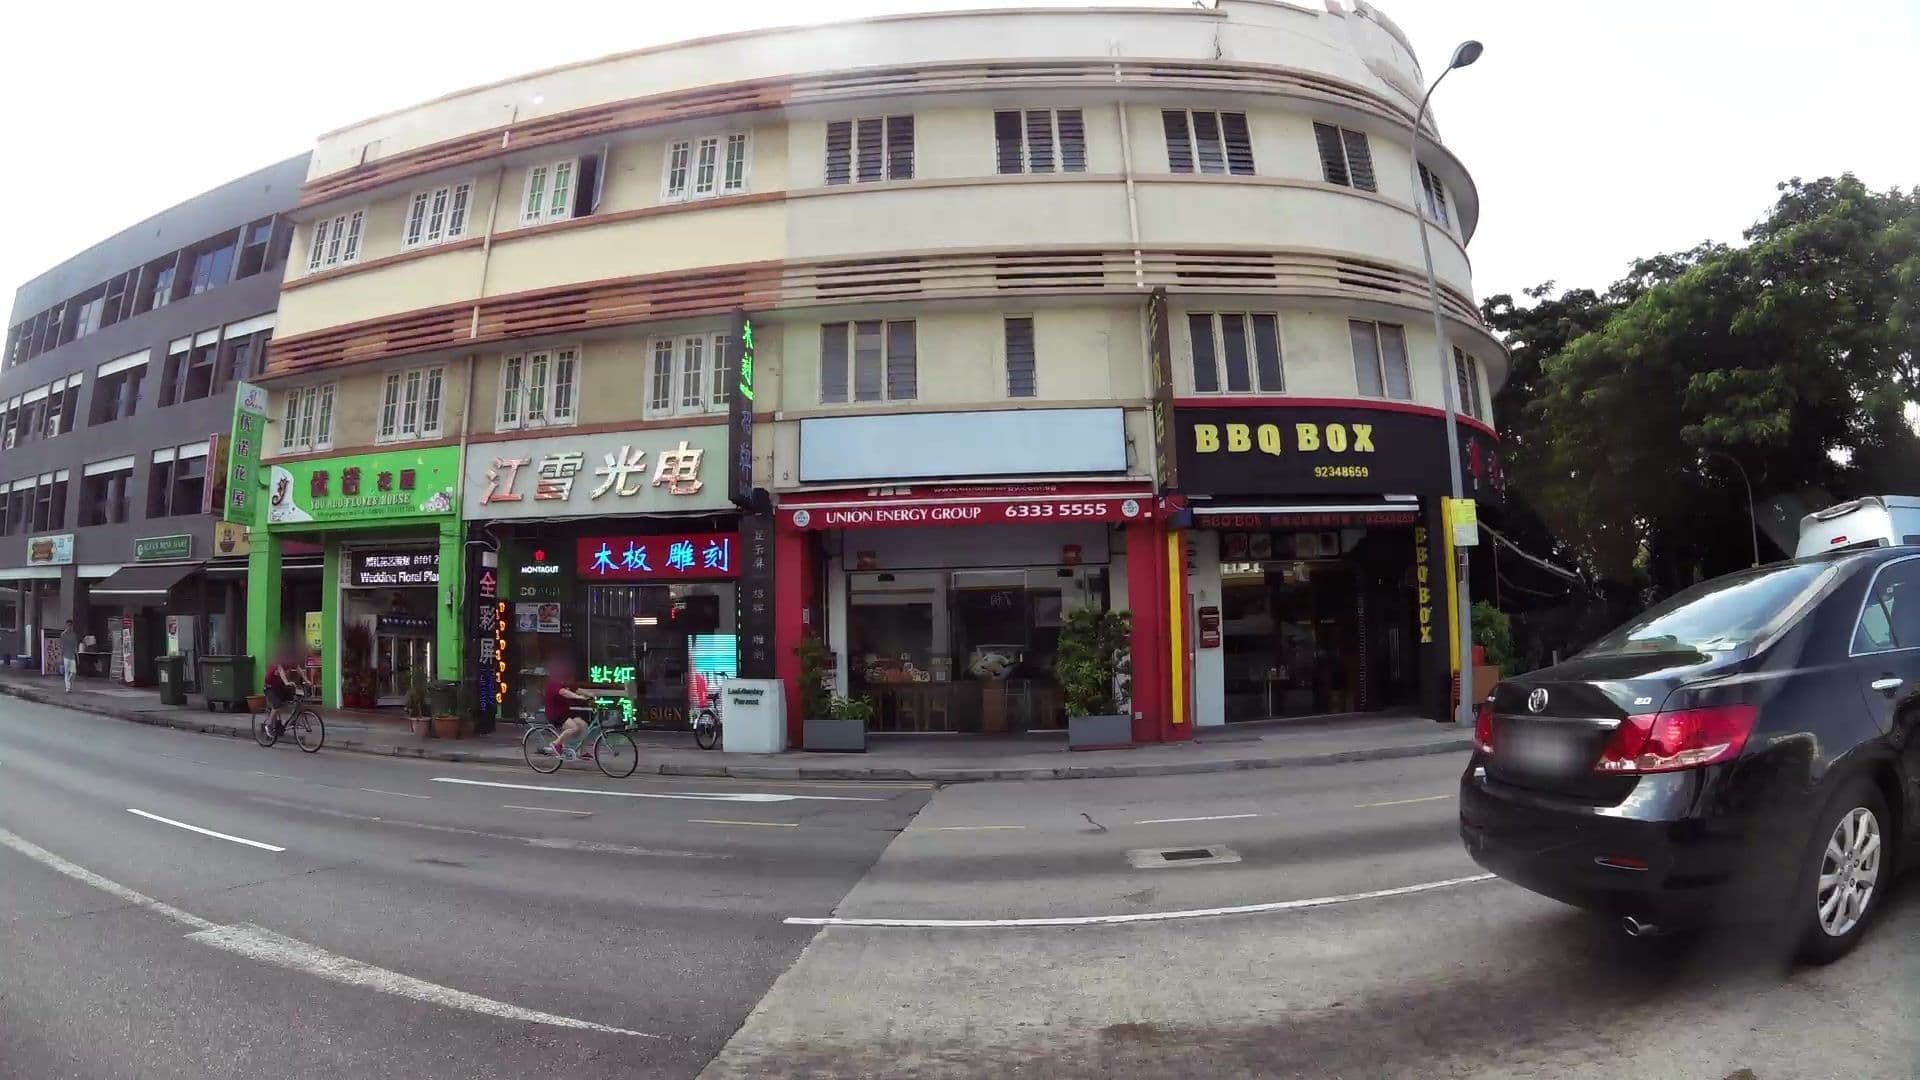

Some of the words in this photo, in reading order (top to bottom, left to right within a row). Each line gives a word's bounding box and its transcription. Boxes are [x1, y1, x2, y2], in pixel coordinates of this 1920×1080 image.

[1194, 423, 1281, 456] BBQ
[1296, 423, 1375, 453] BOX
[480, 440, 704, 506] 江雪光电
[1314, 465, 1369, 479] 92348659
[826, 510, 874, 524] UNION
[876, 508, 929, 522] ENERGY
[931, 506, 981, 521] GROUP
[1005, 503, 1053, 518] 6333
[1058, 502, 1108, 517] 5555
[590, 541, 652, 574] 木板
[665, 537, 730, 573] 雕刻
[360, 571, 397, 583] Wedding
[398, 571, 422, 583] Floral
